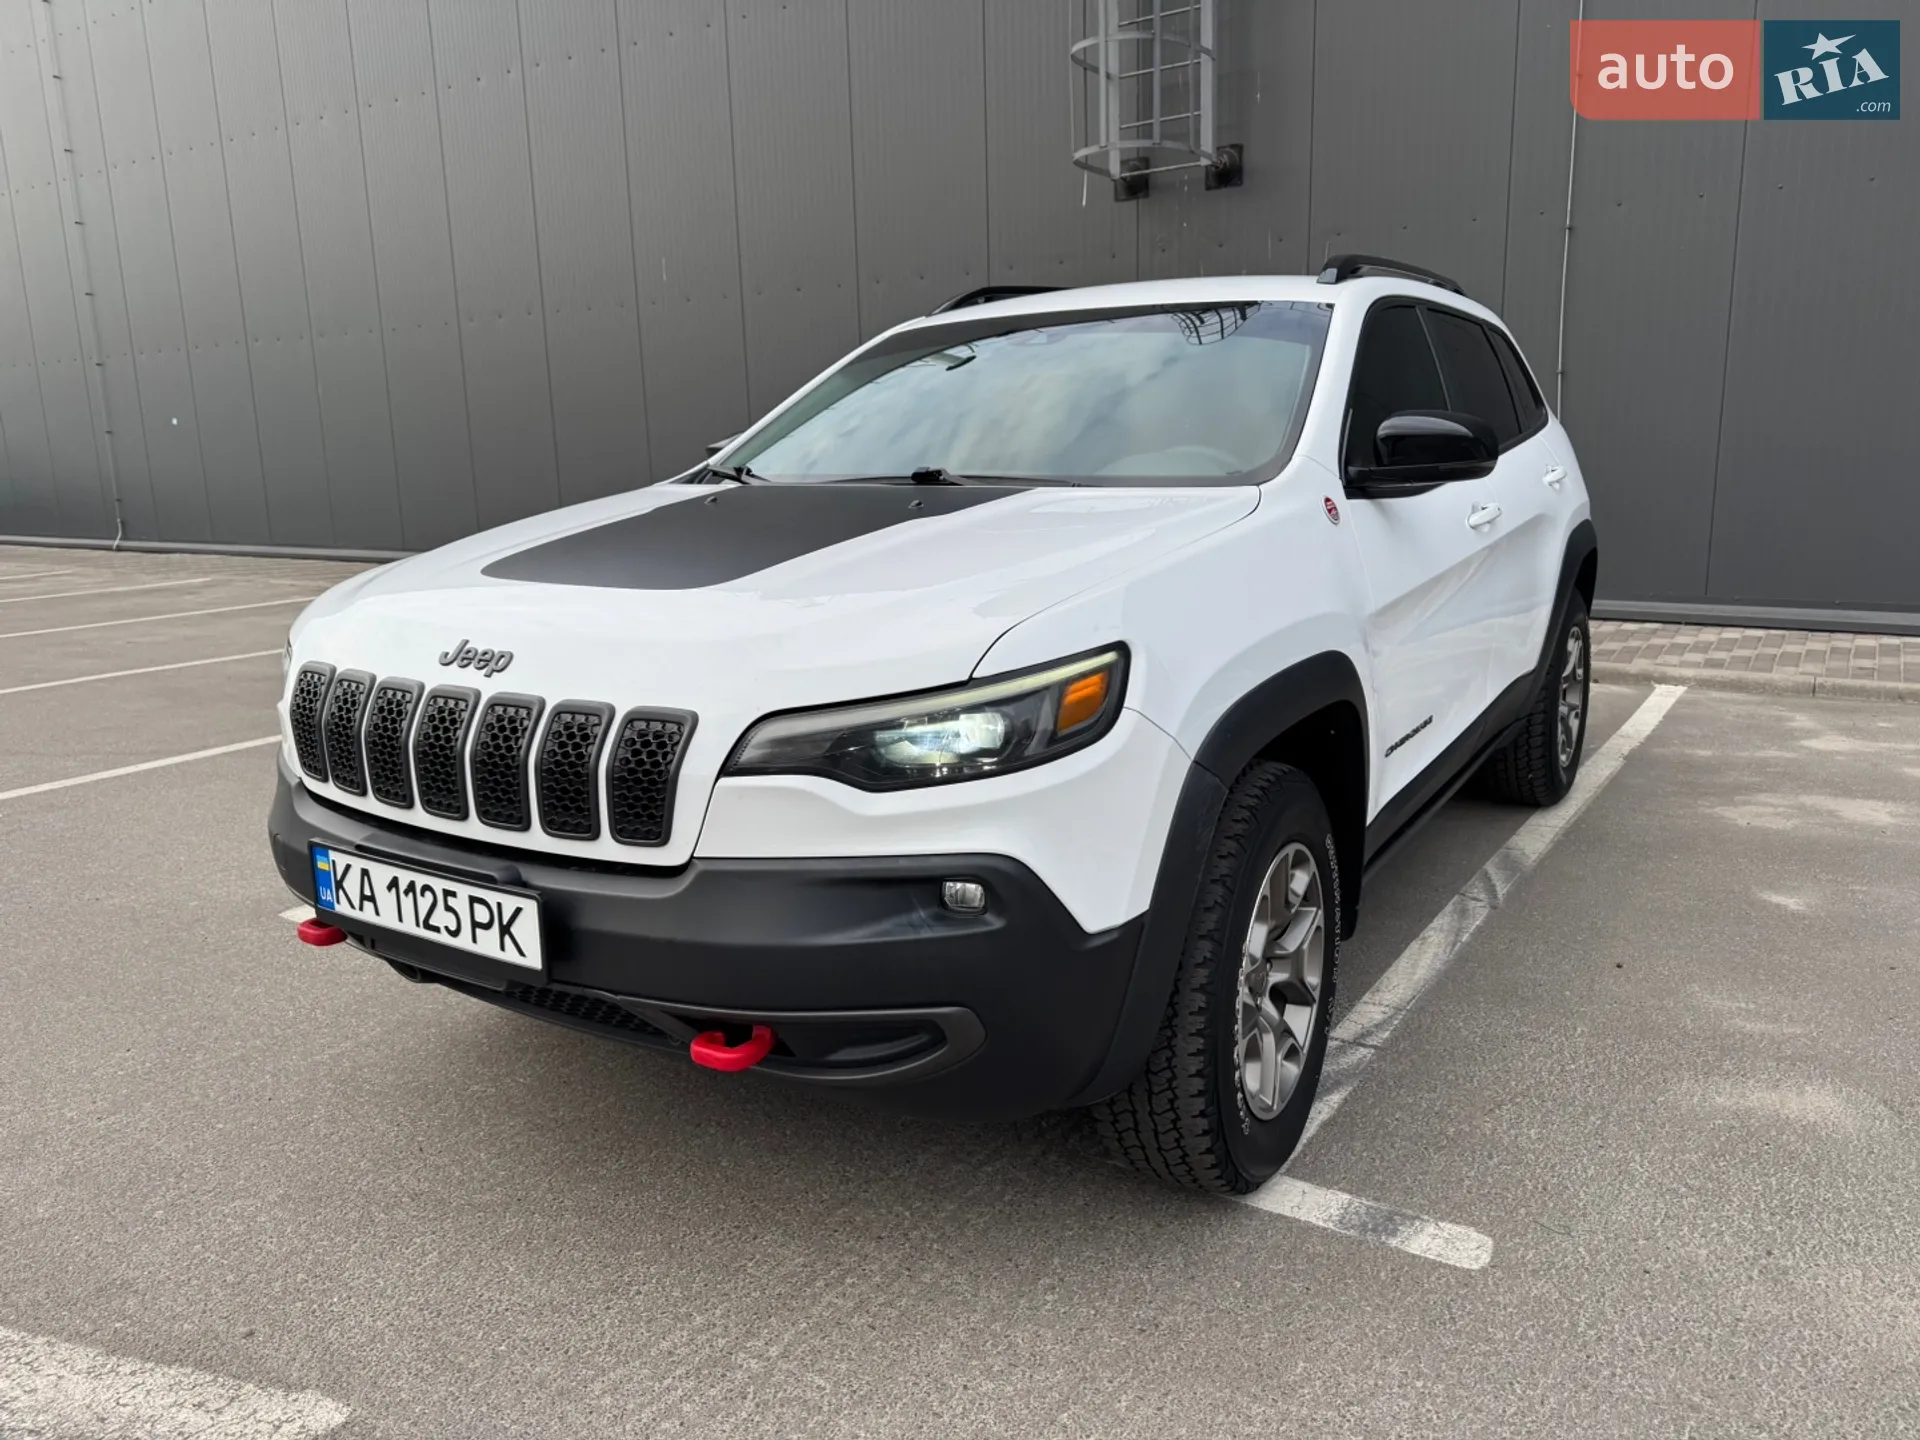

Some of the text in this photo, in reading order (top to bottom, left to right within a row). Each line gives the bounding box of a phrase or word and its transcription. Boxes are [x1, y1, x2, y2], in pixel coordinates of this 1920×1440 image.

[438, 638, 514, 678] Jeep
[319, 886, 334, 903] UA
[331, 859, 380, 916] KA
[386, 875, 461, 938] 1125
